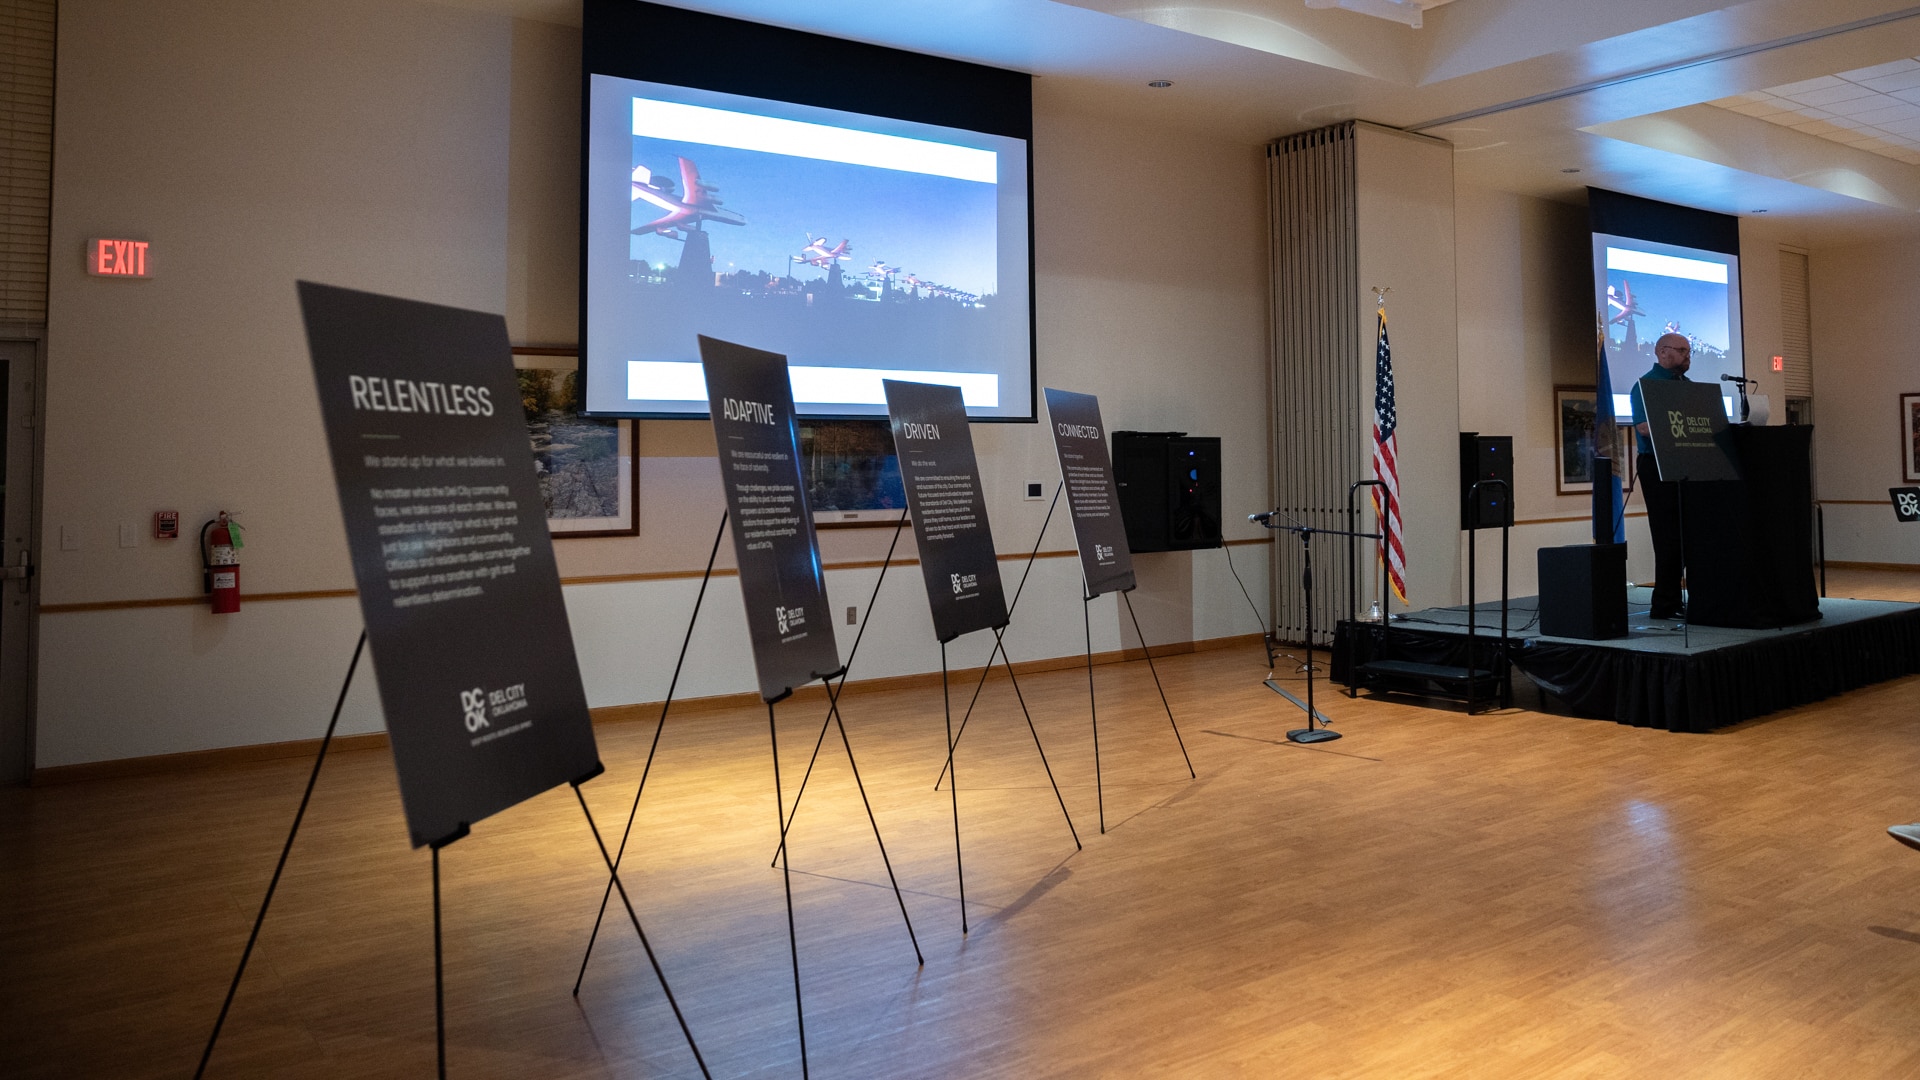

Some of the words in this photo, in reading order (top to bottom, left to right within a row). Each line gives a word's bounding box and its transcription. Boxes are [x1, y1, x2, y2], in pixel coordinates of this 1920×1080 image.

[98, 239, 149, 276] EXIT
[349, 375, 494, 417] RELENTLESS
[723, 397, 776, 426] ADAPTIVE
[1667, 411, 1684, 425] DC
[1686, 416, 1698, 426] DEL
[1698, 417, 1711, 427] CITY
[904, 422, 941, 441] DRIVEN
[1058, 423, 1099, 440] CONNECTED
[1671, 425, 1687, 438] OK
[1897, 493, 1918, 505] DC
[1900, 504, 1920, 516] OK
[951, 573, 960, 584] DC
[953, 583, 963, 594] OK
[776, 606, 786, 621] DC
[779, 620, 789, 634] OK
[460, 687, 485, 713] DC
[489, 689, 506, 706] DEL
[505, 682, 525, 701] CITY
[492, 698, 528, 717] OKLAHOMA
[465, 707, 490, 733] OK
